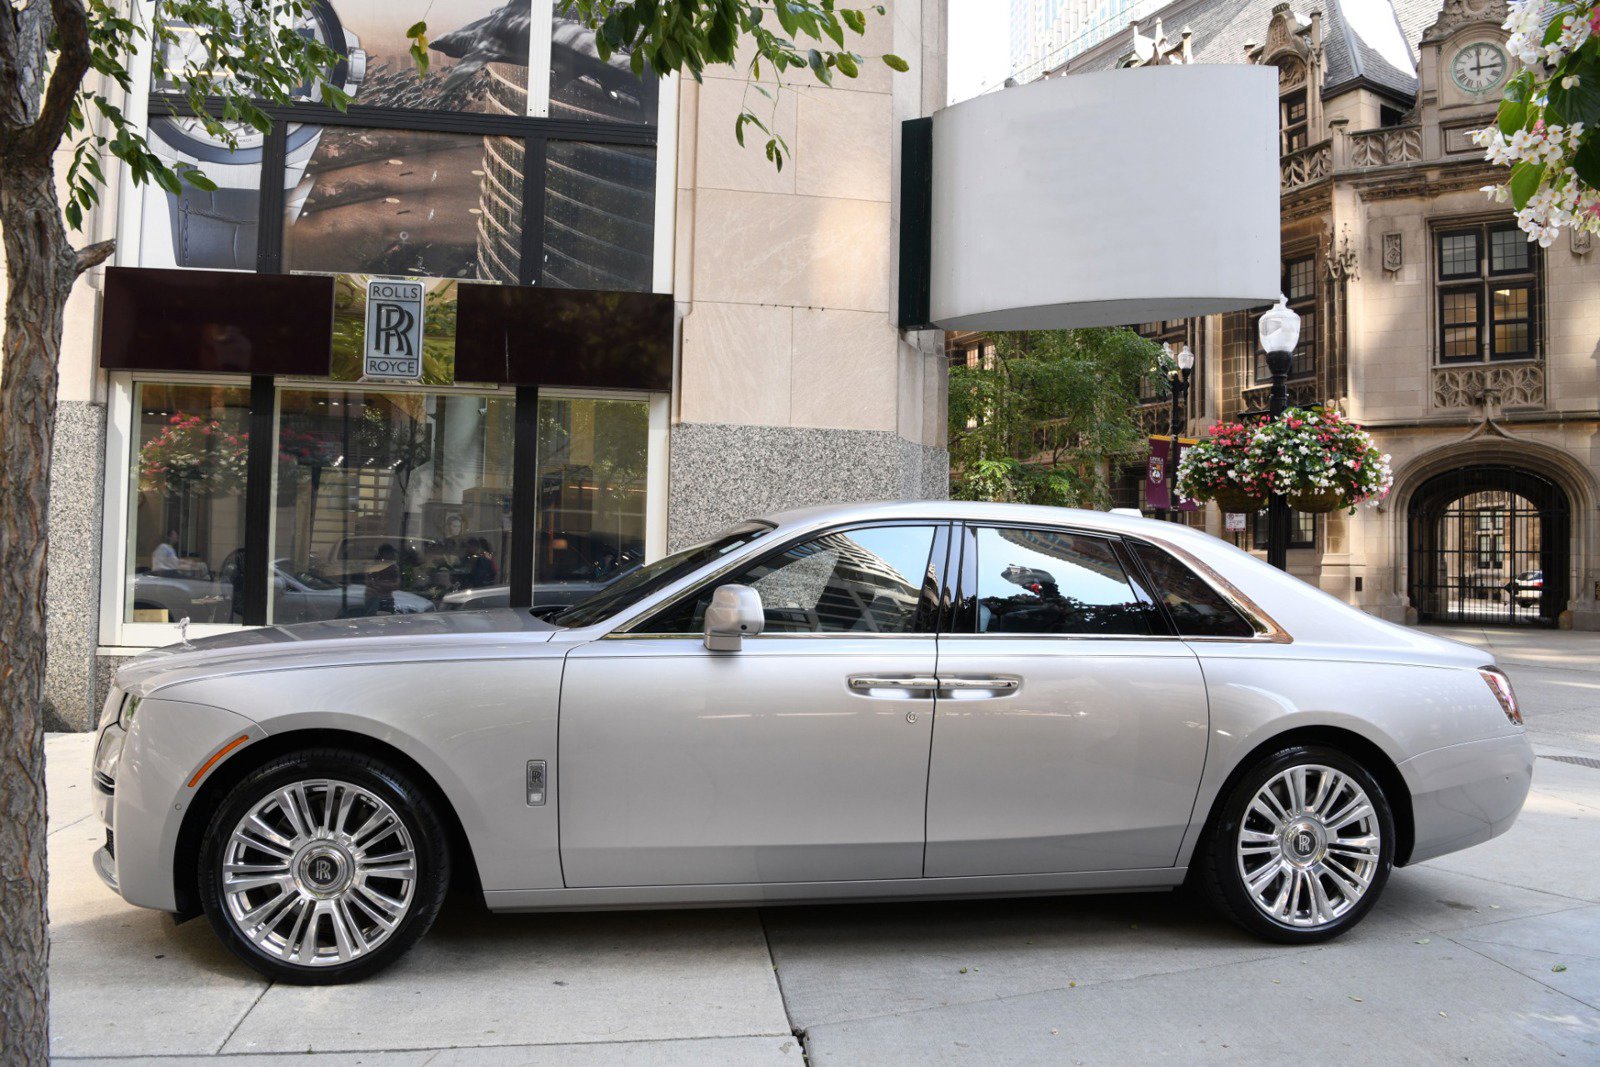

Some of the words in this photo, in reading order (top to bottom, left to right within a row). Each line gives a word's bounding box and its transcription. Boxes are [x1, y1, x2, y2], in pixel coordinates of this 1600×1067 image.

[373, 286, 418, 299] ROLLS
[374, 303, 414, 356] RR
[369, 361, 415, 374] ROYCE
